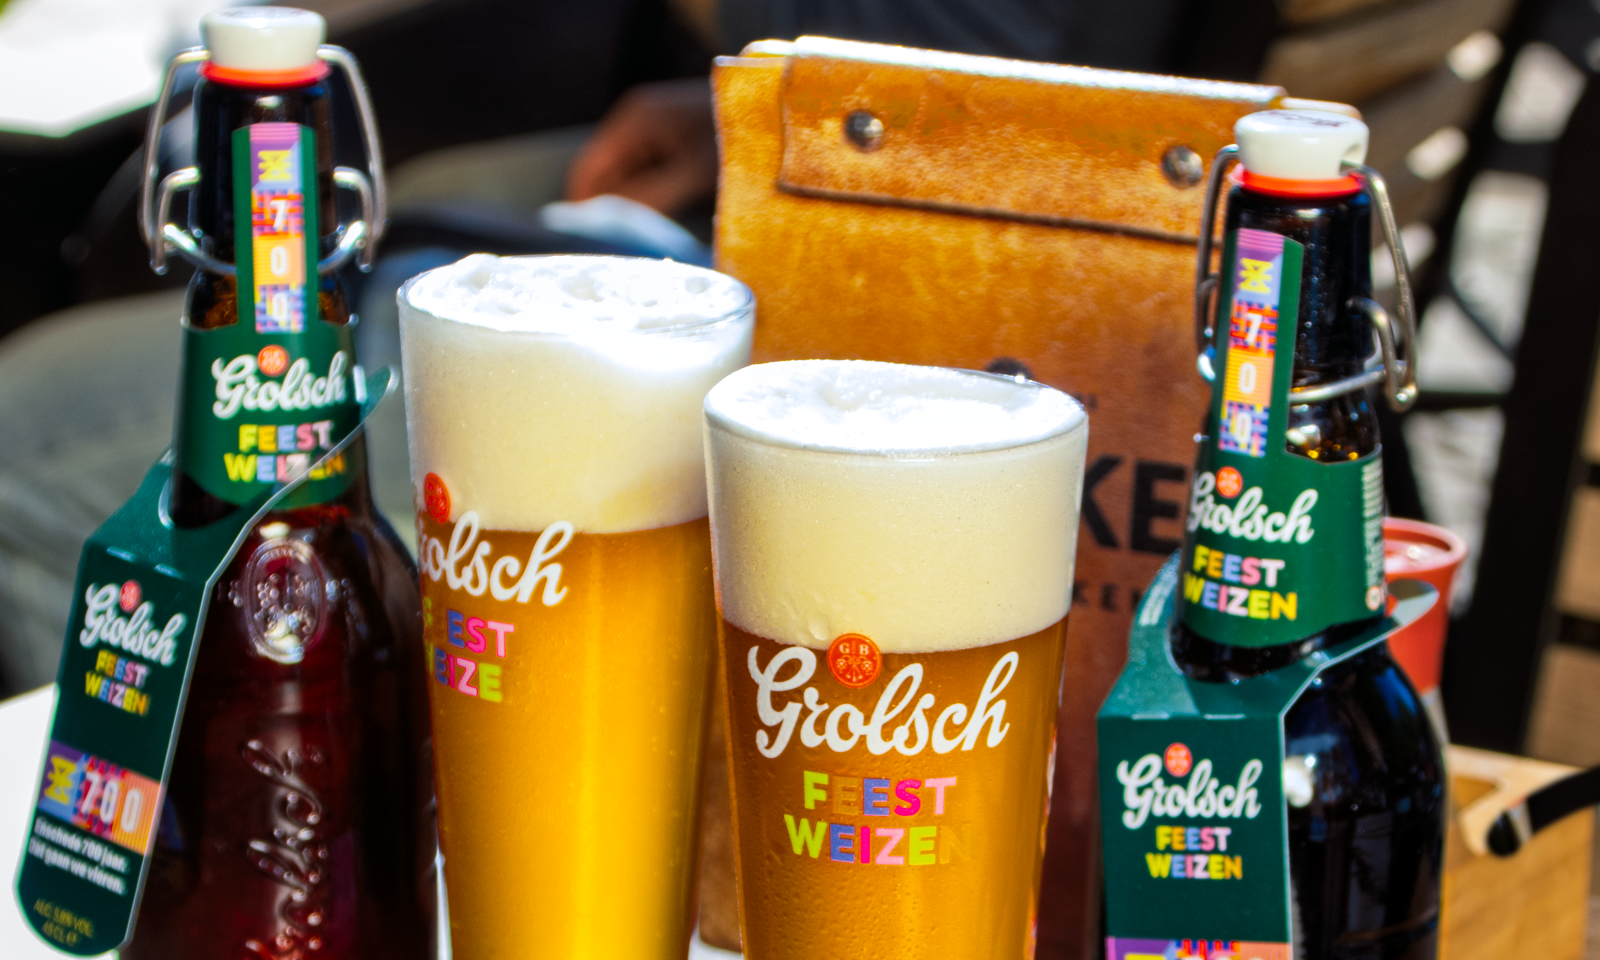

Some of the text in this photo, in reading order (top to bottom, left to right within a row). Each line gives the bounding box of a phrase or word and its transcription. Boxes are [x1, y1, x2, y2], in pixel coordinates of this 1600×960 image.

[211, 350, 347, 420] Grolsch
[239, 420, 333, 453] FEEST
[1186, 471, 1318, 544] Grolsch
[1193, 544, 1285, 588] FEEST
[1184, 571, 1297, 621] WEIZEN
[80, 582, 187, 666] Grolsch
[84, 671, 150, 715] WEIZEN
[95, 650, 149, 688] FEEST
[747, 645, 1019, 759] Grolsch
[80, 771, 142, 834] 700
[803, 770, 957, 817] FEEST
[1116, 753, 1263, 830] Grolsch
[1155, 825, 1231, 851] FEEST
[1146, 853, 1242, 880] WEIZEN
